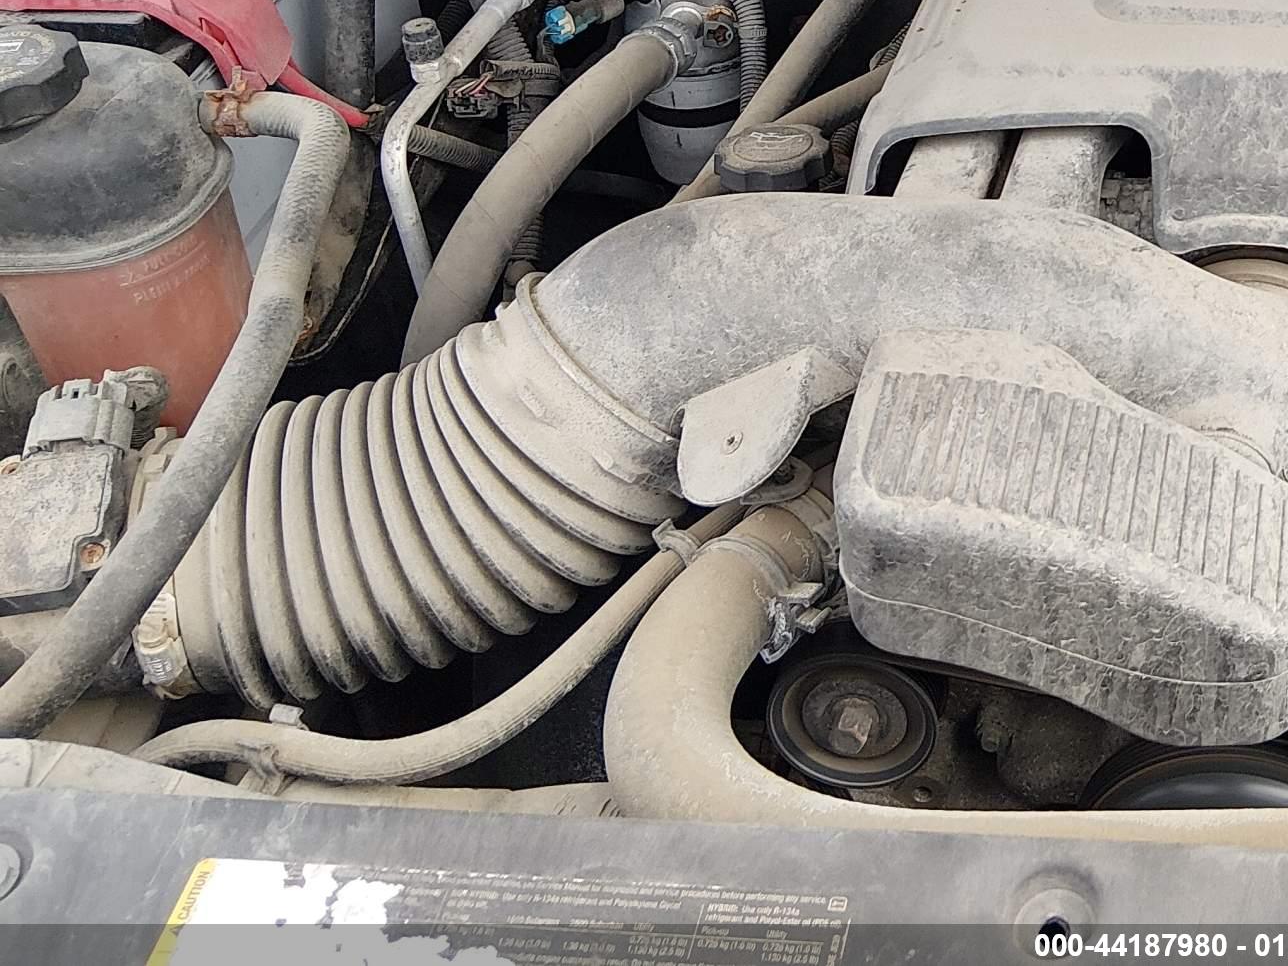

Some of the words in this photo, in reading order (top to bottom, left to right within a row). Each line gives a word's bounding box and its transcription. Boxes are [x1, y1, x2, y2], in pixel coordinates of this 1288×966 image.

[178, 870, 210, 920] CAUTION
[533, 894, 559, 903] R-134a
[680, 889, 720, 899] procedures
[721, 891, 745, 900] before
[745, 892, 785, 904] performing
[785, 895, 799, 904] any
[741, 904, 756, 914] Use
[756, 906, 773, 916] only
[773, 906, 800, 916] R-134a
[705, 914, 744, 924] refrigerant
[744, 915, 759, 924] and
[766, 929, 788, 940] Utility
